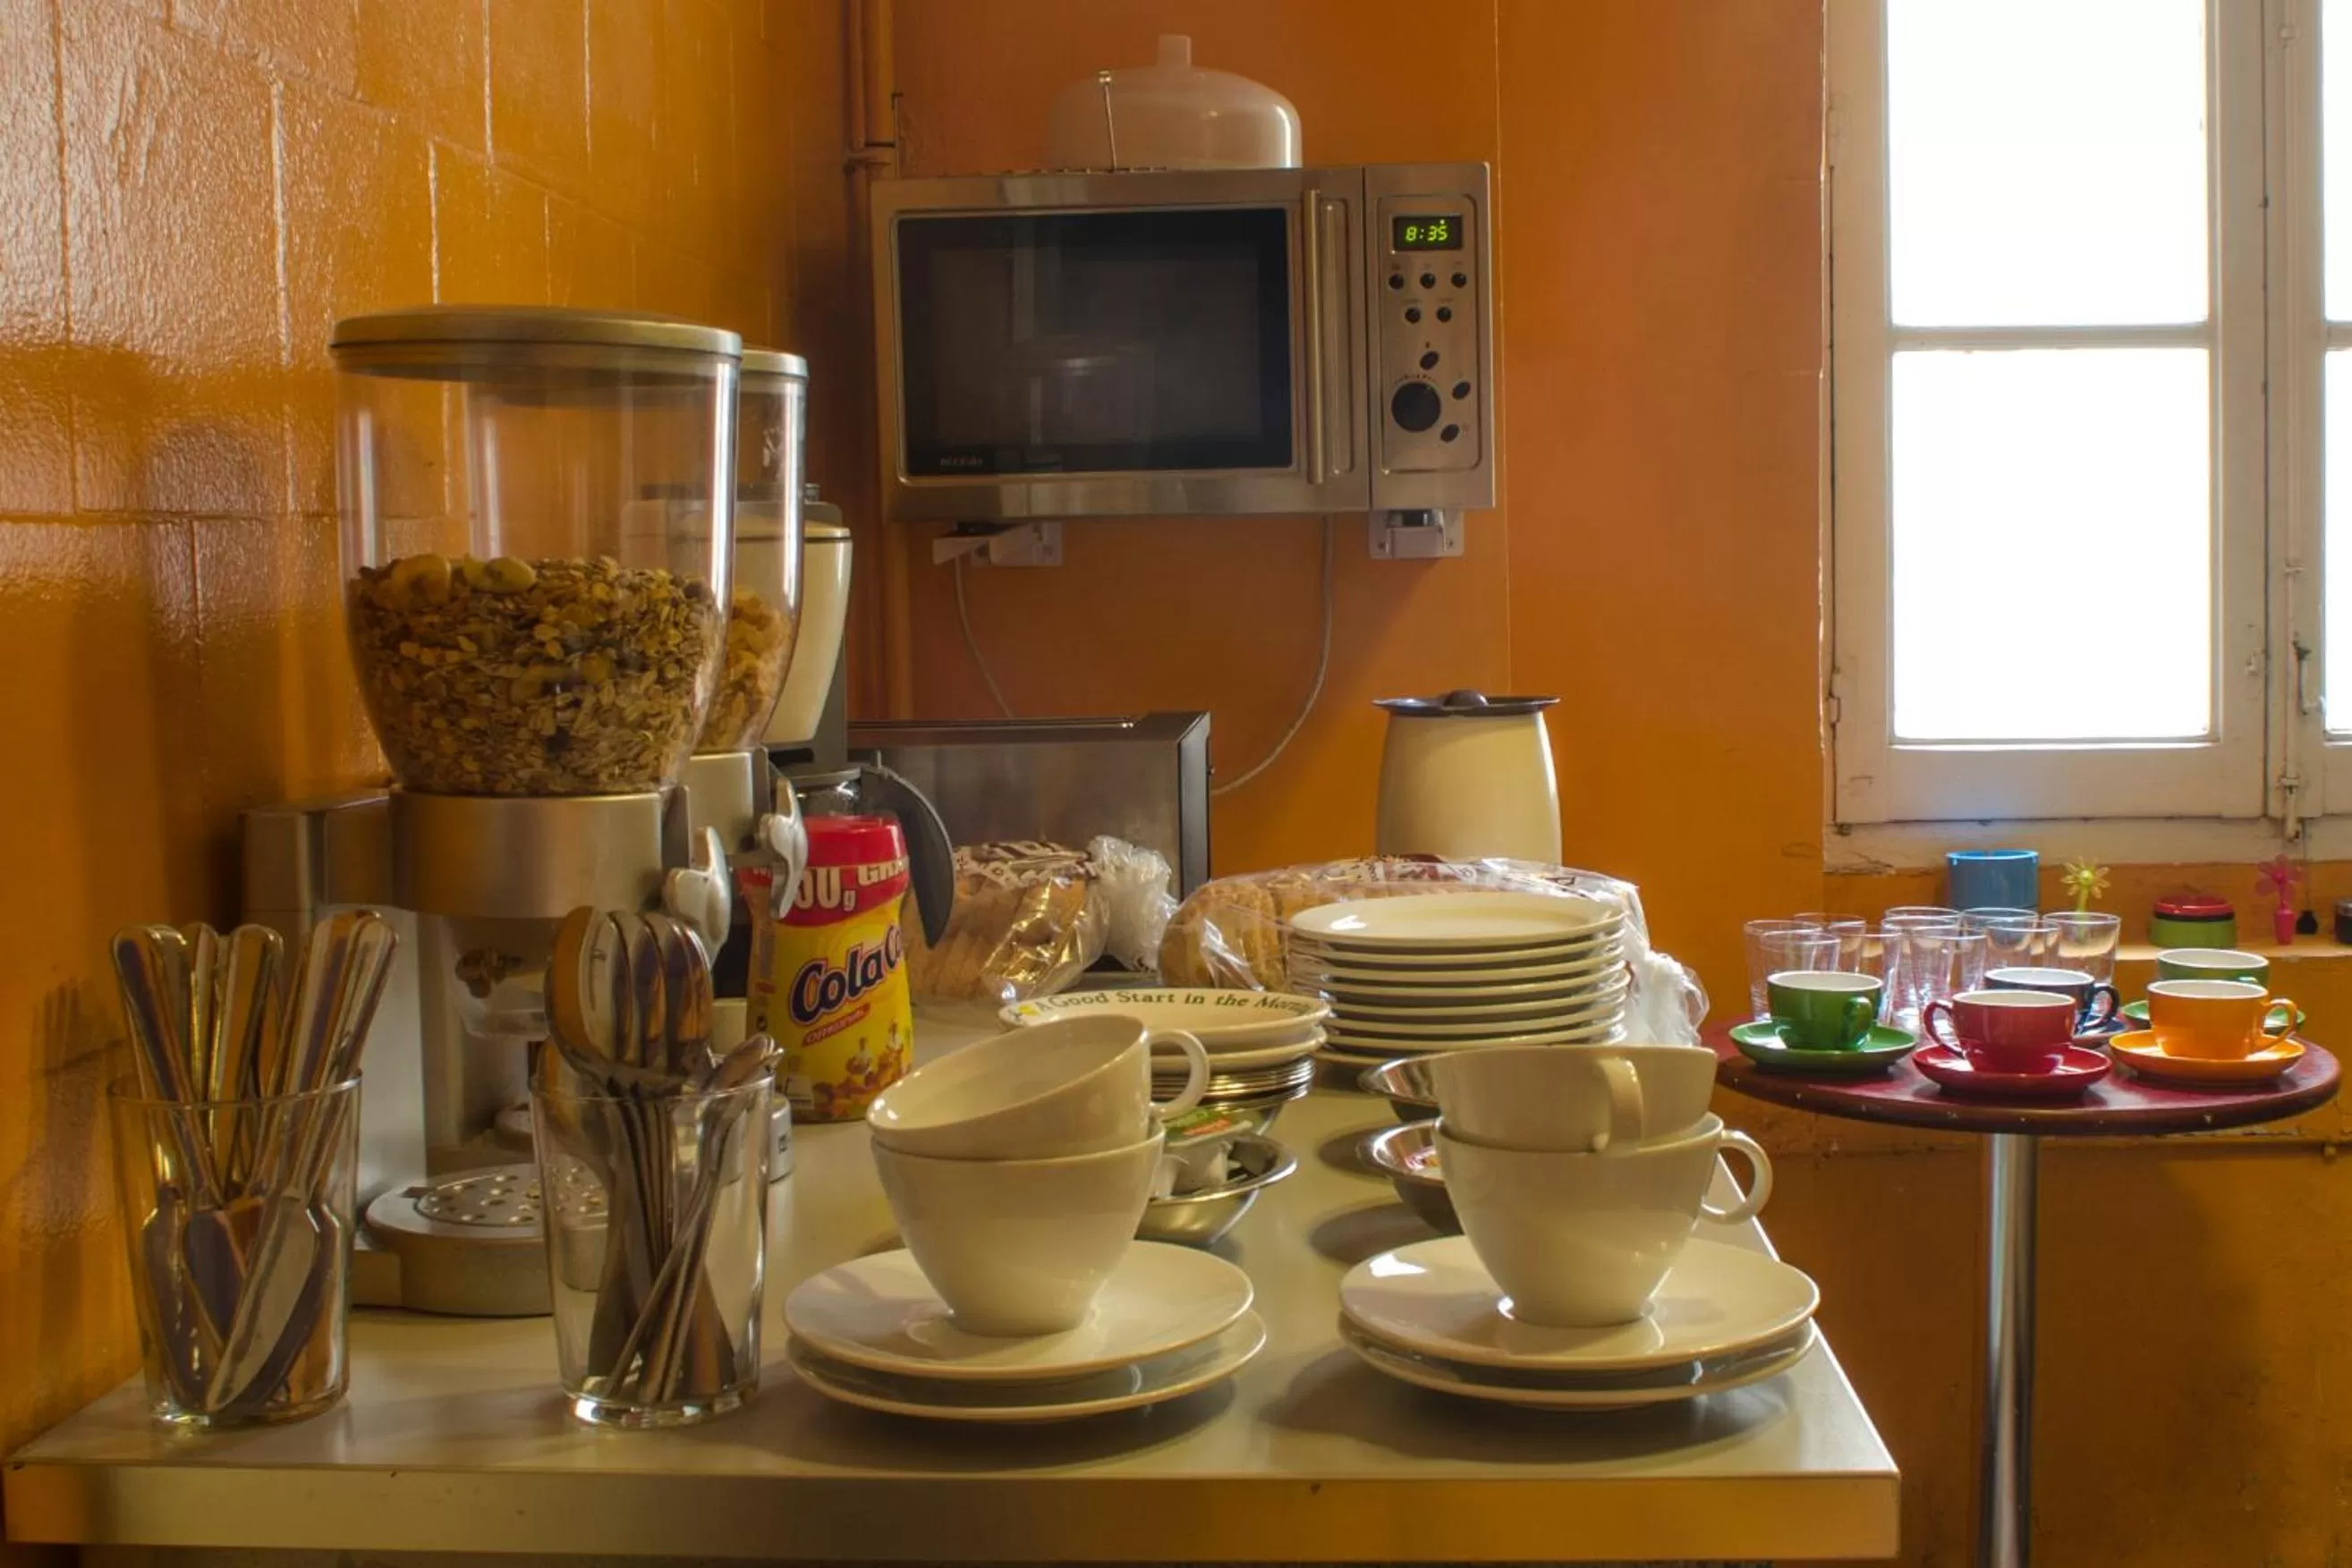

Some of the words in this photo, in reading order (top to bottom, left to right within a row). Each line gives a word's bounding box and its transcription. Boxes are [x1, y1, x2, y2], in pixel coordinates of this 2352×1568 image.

[1405, 225, 1448, 241] 8:35
[1048, 992, 1110, 1007] Good
[1116, 990, 1176, 1004] Start
[1184, 992, 1206, 1004] in
[1213, 993, 1250, 1007] the
